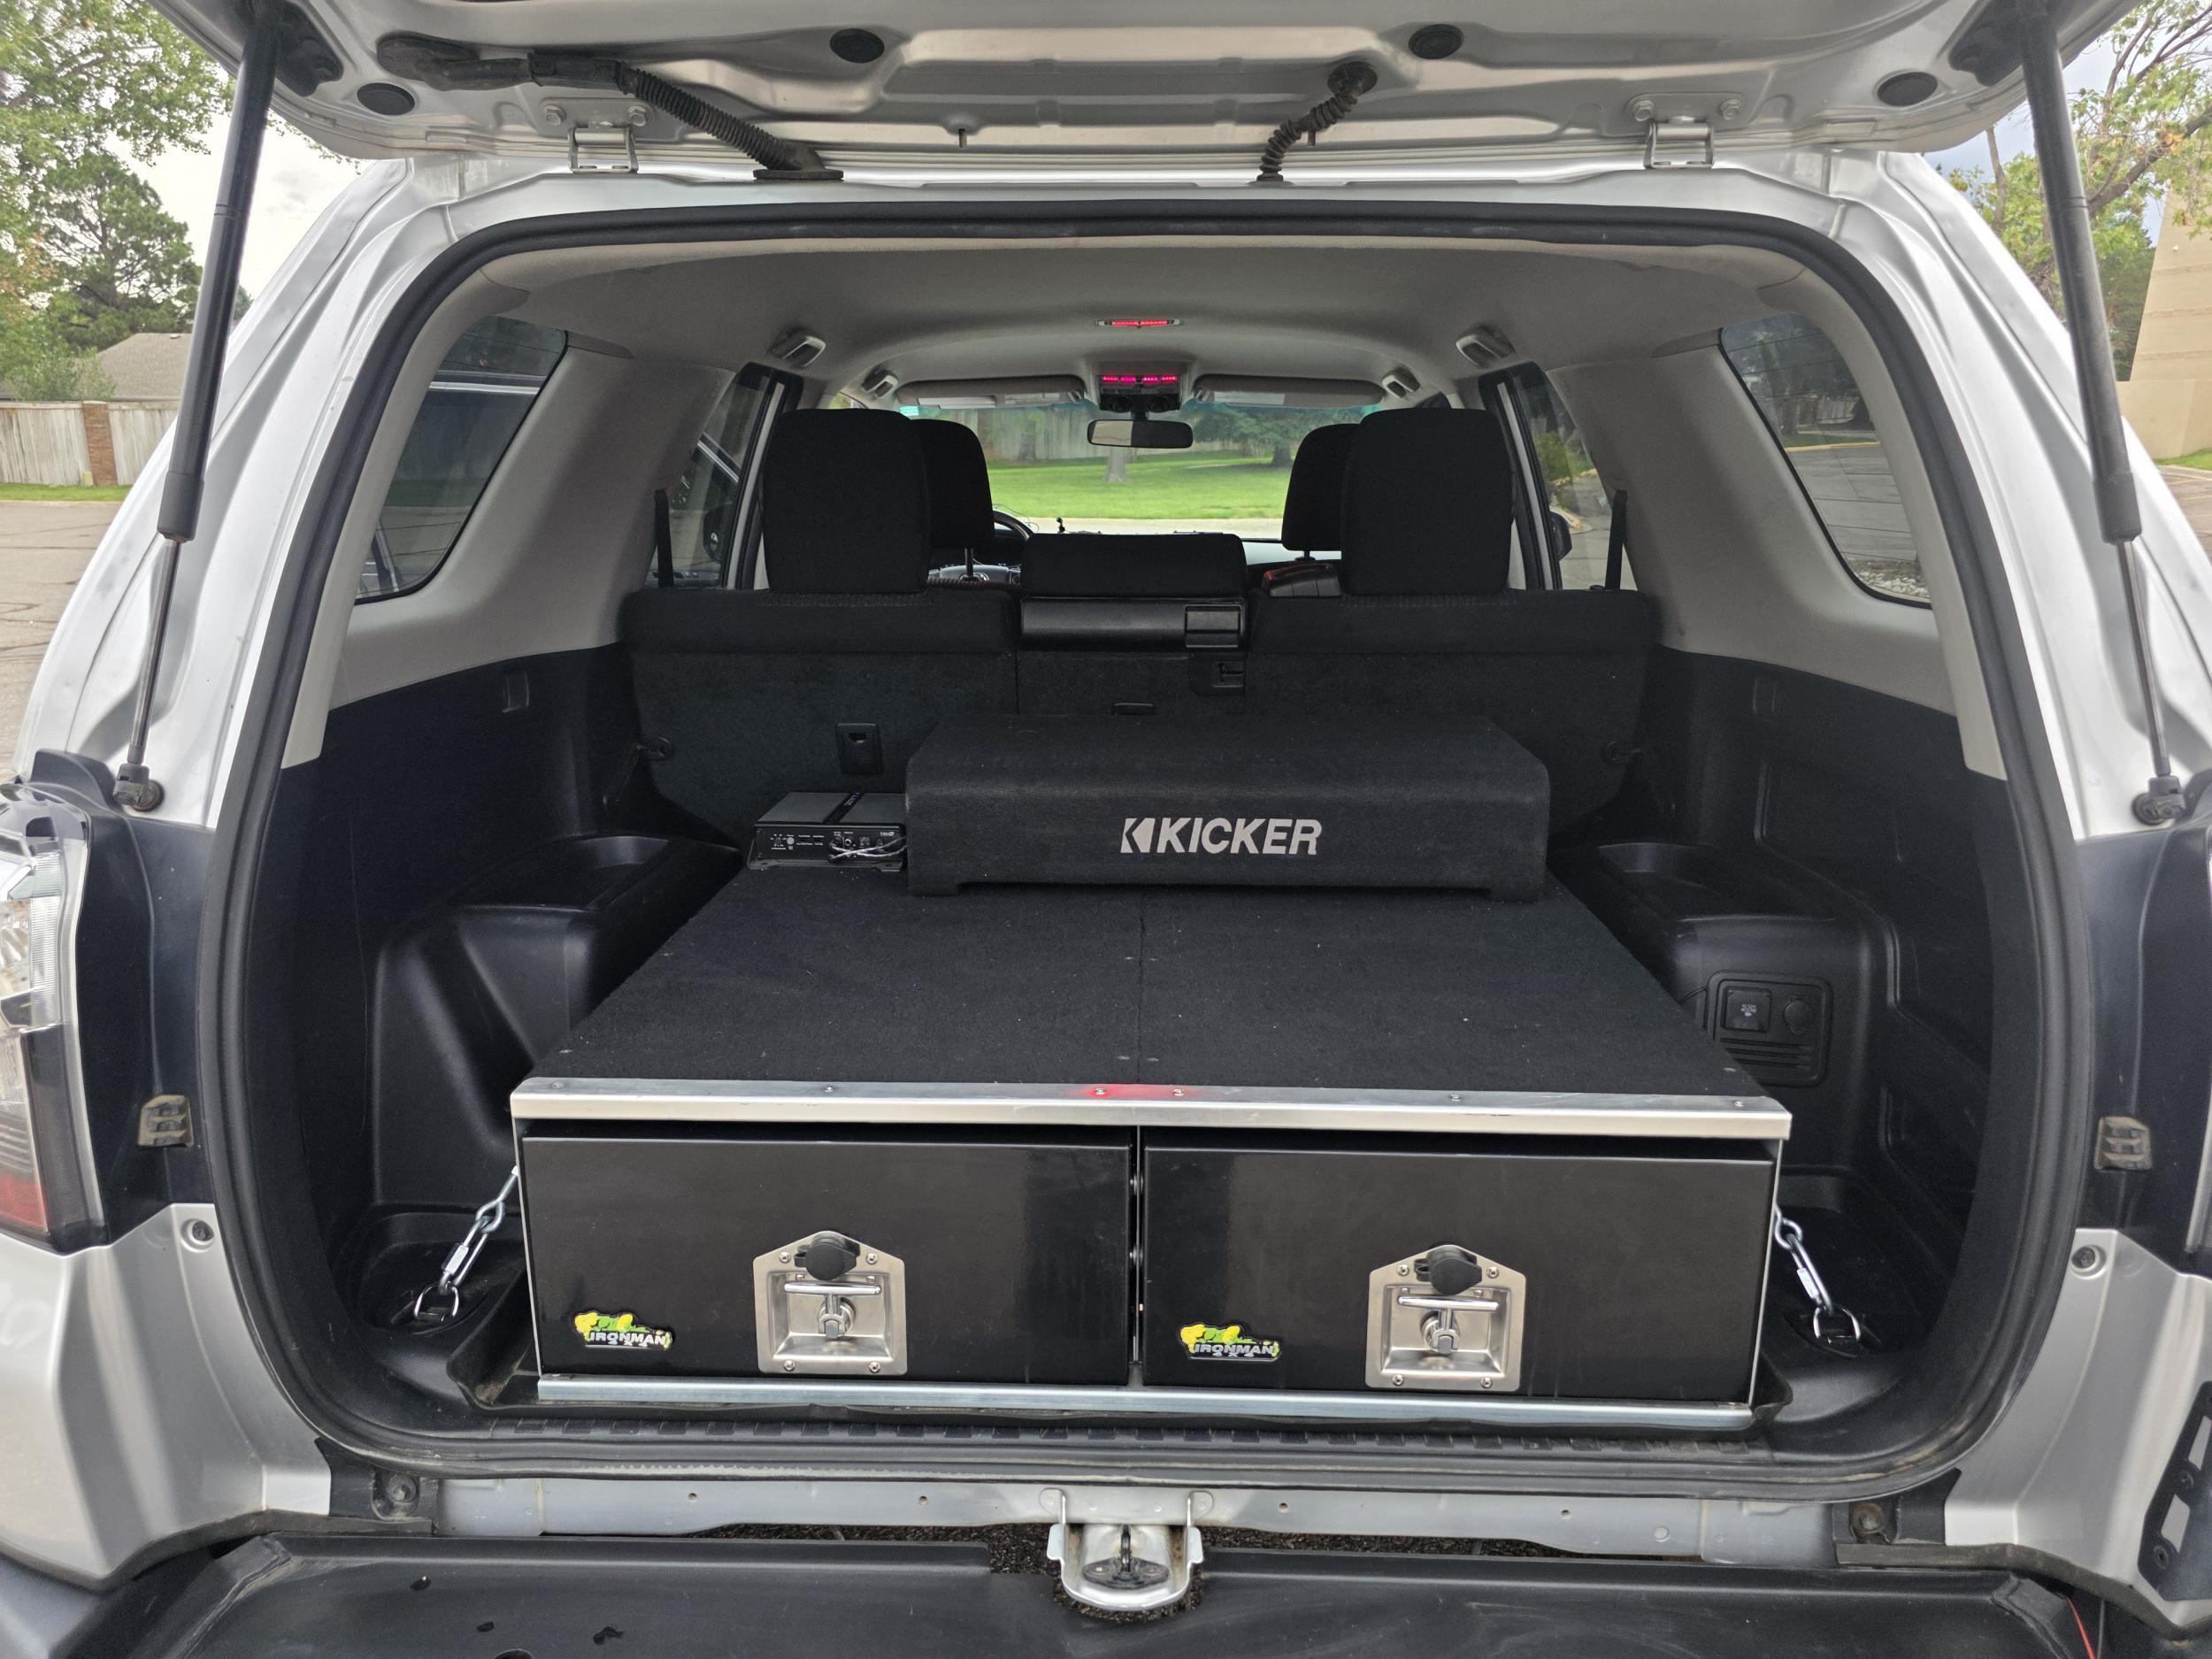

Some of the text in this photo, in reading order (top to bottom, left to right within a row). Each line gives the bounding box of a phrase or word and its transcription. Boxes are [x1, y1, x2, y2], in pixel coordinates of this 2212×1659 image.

[1156, 817, 1323, 856] KICKER
[590, 1333, 666, 1345] IRONMAN
[1194, 1344, 1274, 1355] IRONMAN
